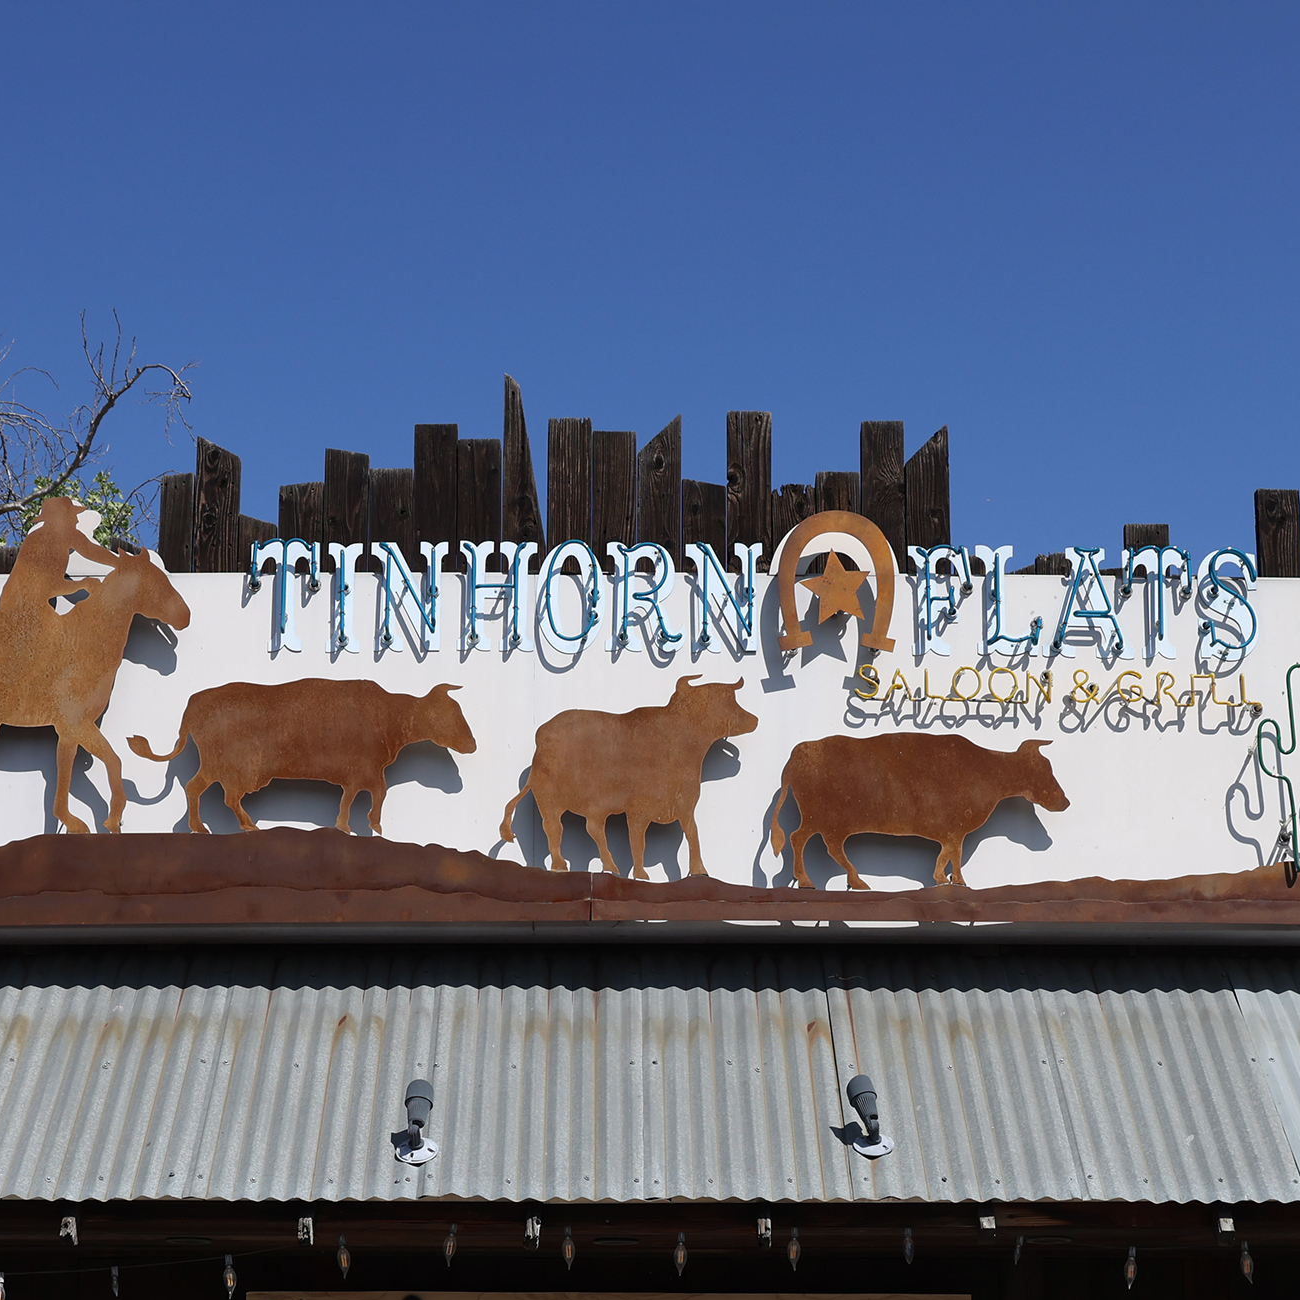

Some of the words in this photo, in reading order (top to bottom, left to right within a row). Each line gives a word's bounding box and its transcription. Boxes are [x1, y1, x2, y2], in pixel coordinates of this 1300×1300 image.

[249, 537, 763, 655] TINHORN
[907, 543, 1259, 661] FLATS
[854, 664, 1052, 705] SALOON
[1071, 668, 1099, 705] &
[1116, 669, 1263, 712] GRILL
